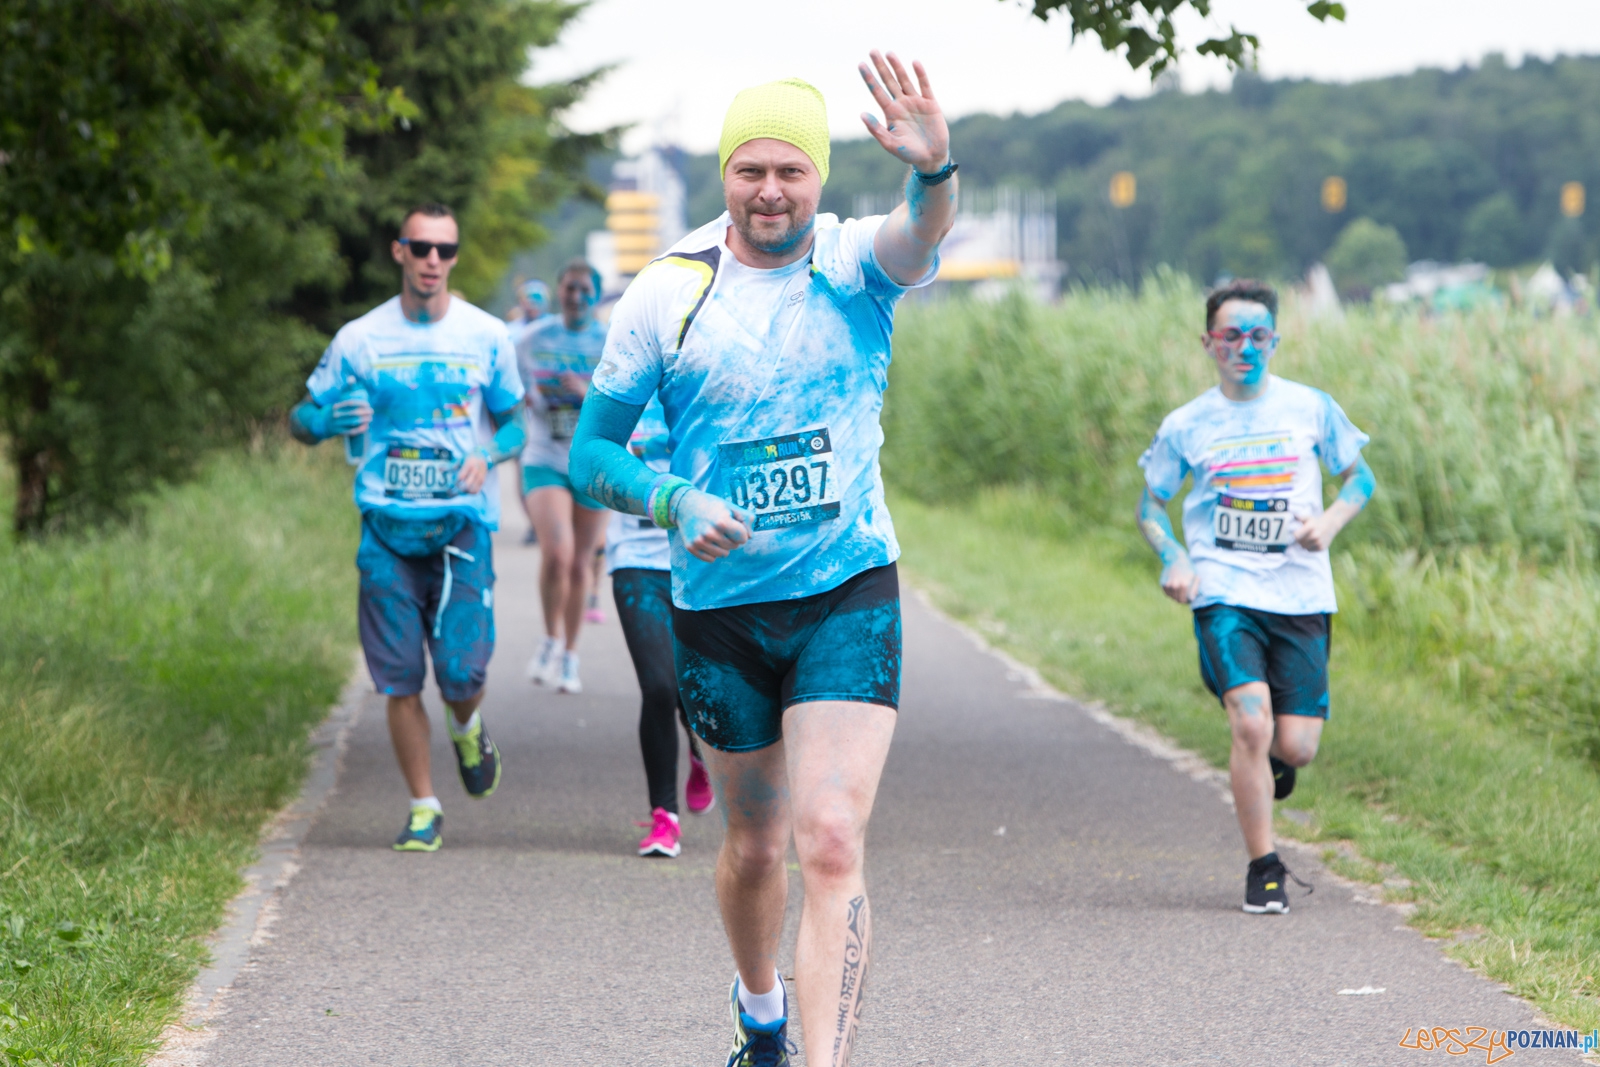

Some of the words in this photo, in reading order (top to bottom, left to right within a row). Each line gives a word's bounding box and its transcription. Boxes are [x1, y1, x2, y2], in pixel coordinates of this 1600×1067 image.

[778, 441, 799, 457] RUN
[729, 461, 828, 510] 03297
[1219, 512, 1284, 541] 01497
